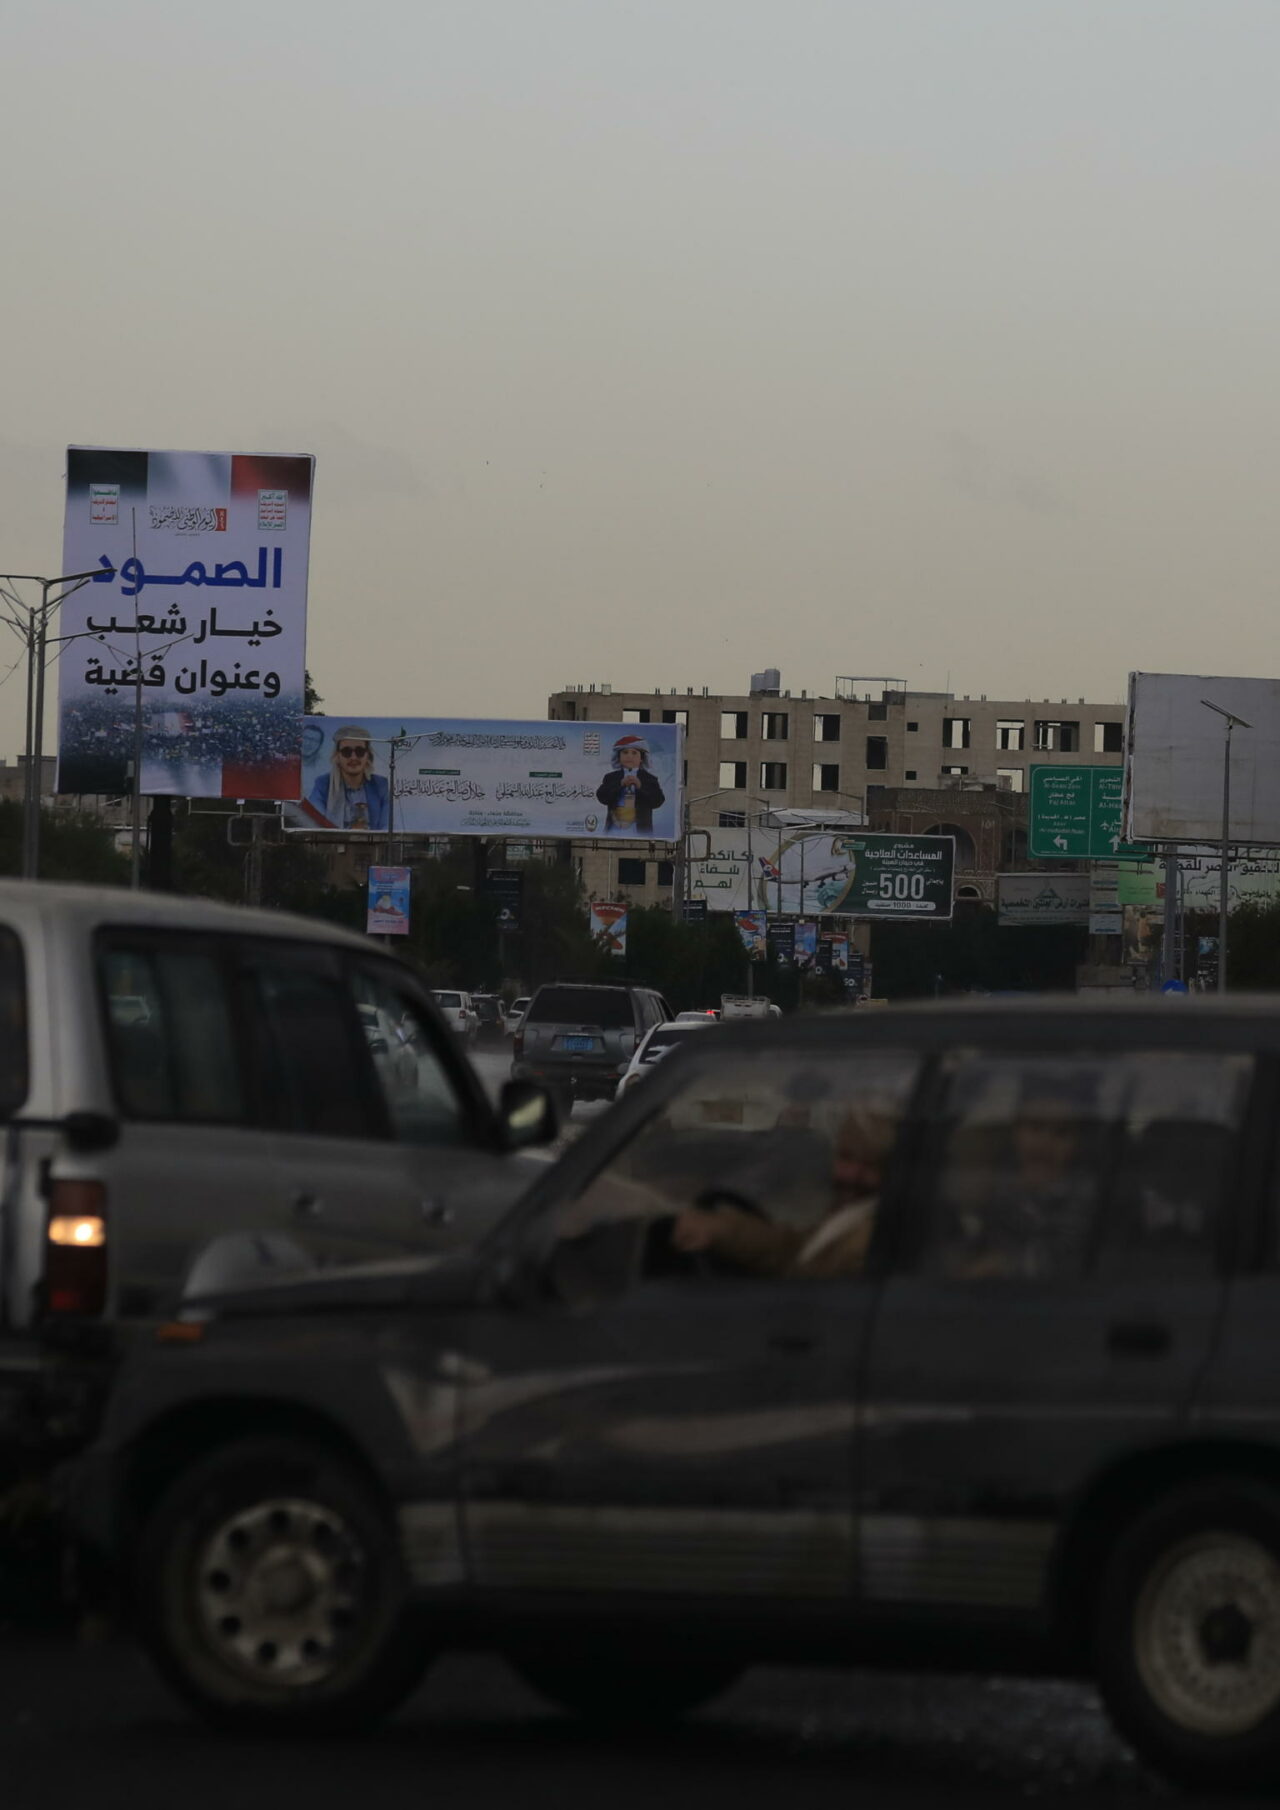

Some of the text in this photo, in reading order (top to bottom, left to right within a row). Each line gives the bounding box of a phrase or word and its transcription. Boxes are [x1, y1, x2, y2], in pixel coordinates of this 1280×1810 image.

[93, 547, 282, 596] الصمود
[87, 603, 283, 646] خيار شعب
[85, 655, 281, 698] وعنوان قضية
[864, 848, 943, 860] المساعدات العلاجية
[693, 878, 732, 889] لهم
[879, 873, 925, 900] 500
